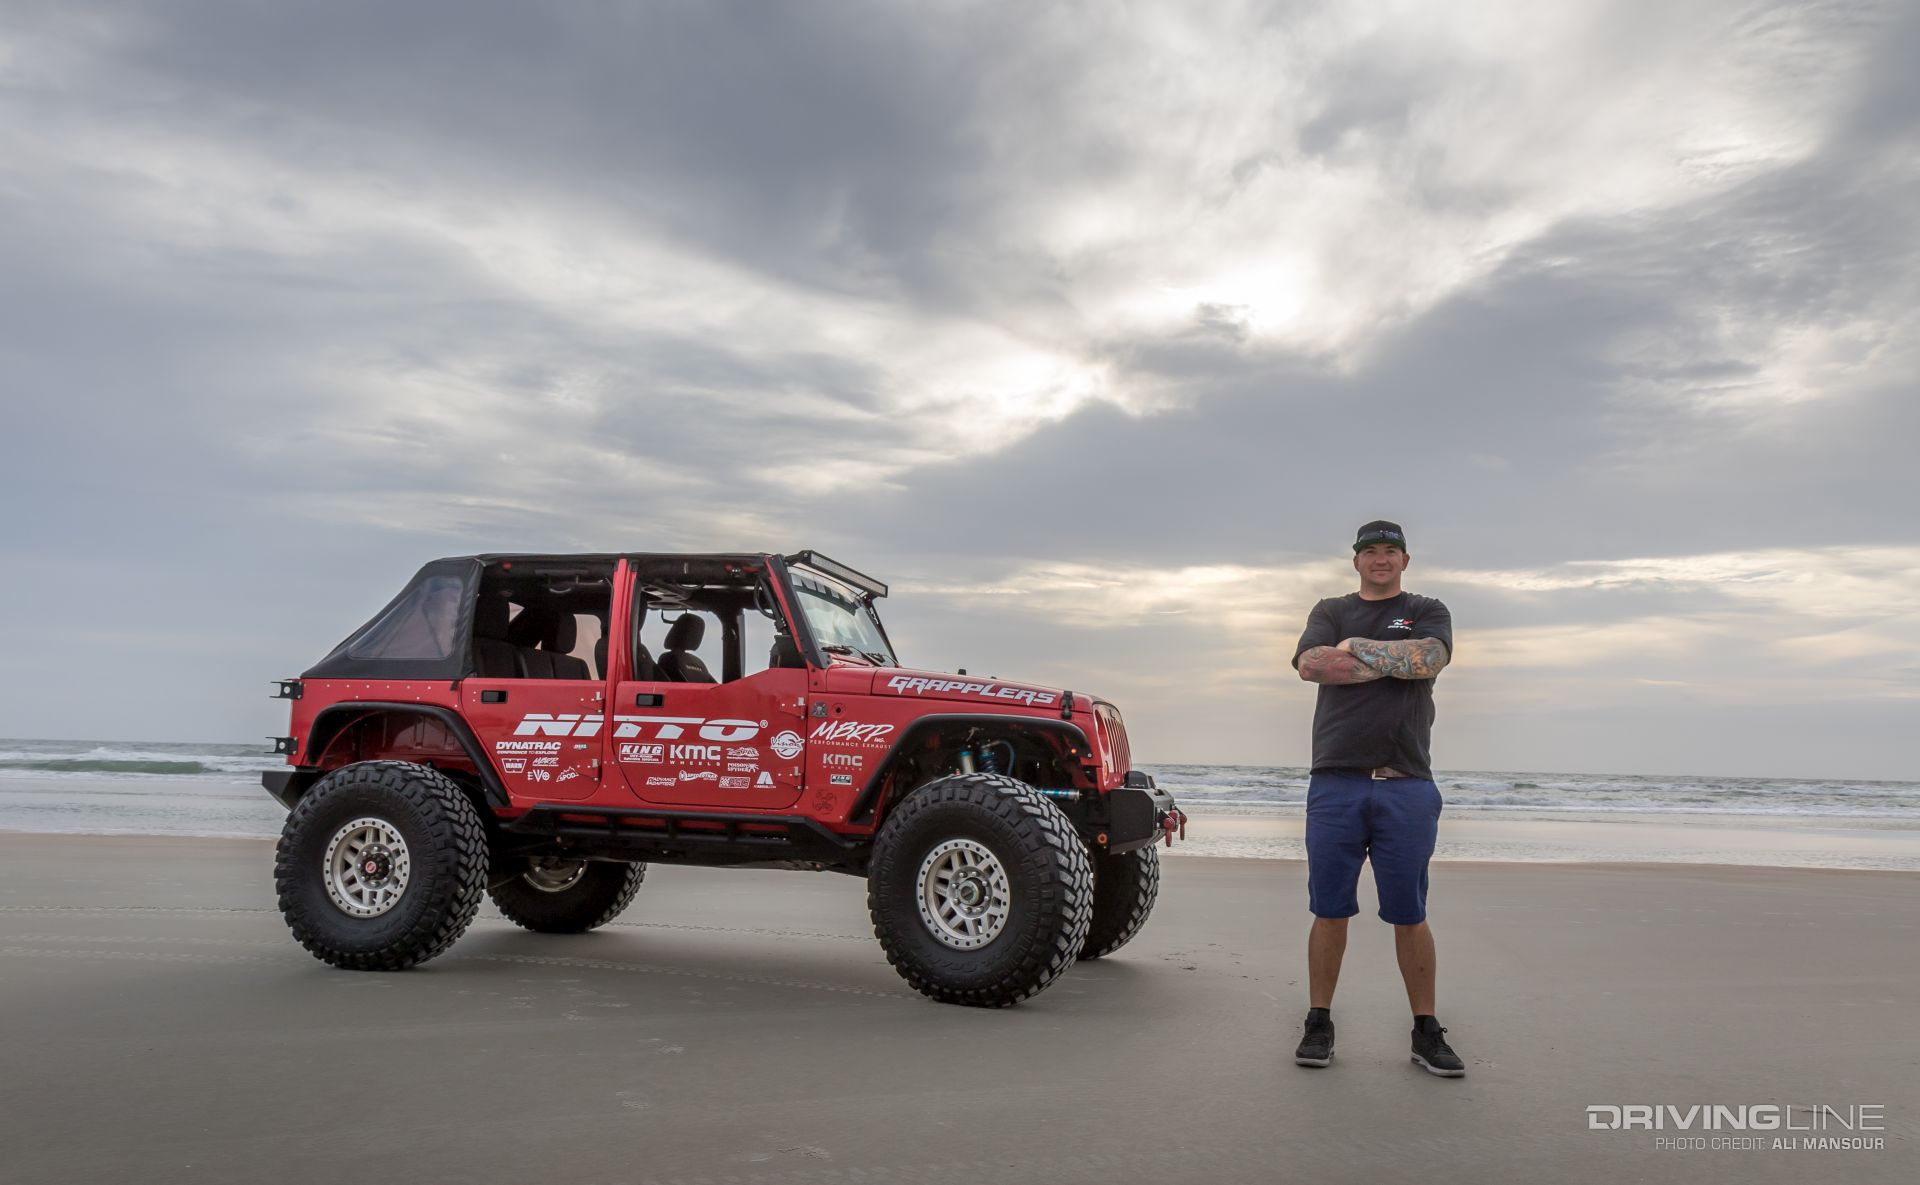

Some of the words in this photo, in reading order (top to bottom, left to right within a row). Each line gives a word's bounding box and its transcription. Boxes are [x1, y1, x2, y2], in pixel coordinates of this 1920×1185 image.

[888, 676, 1056, 705] GRAPPLERS
[513, 713, 759, 741] NITTO
[810, 720, 894, 742] MBRP
[496, 742, 561, 750] DYNATRAC
[621, 745, 662, 755] KING
[810, 740, 859, 748] PERFORMANCE
[670, 745, 720, 760] KMC
